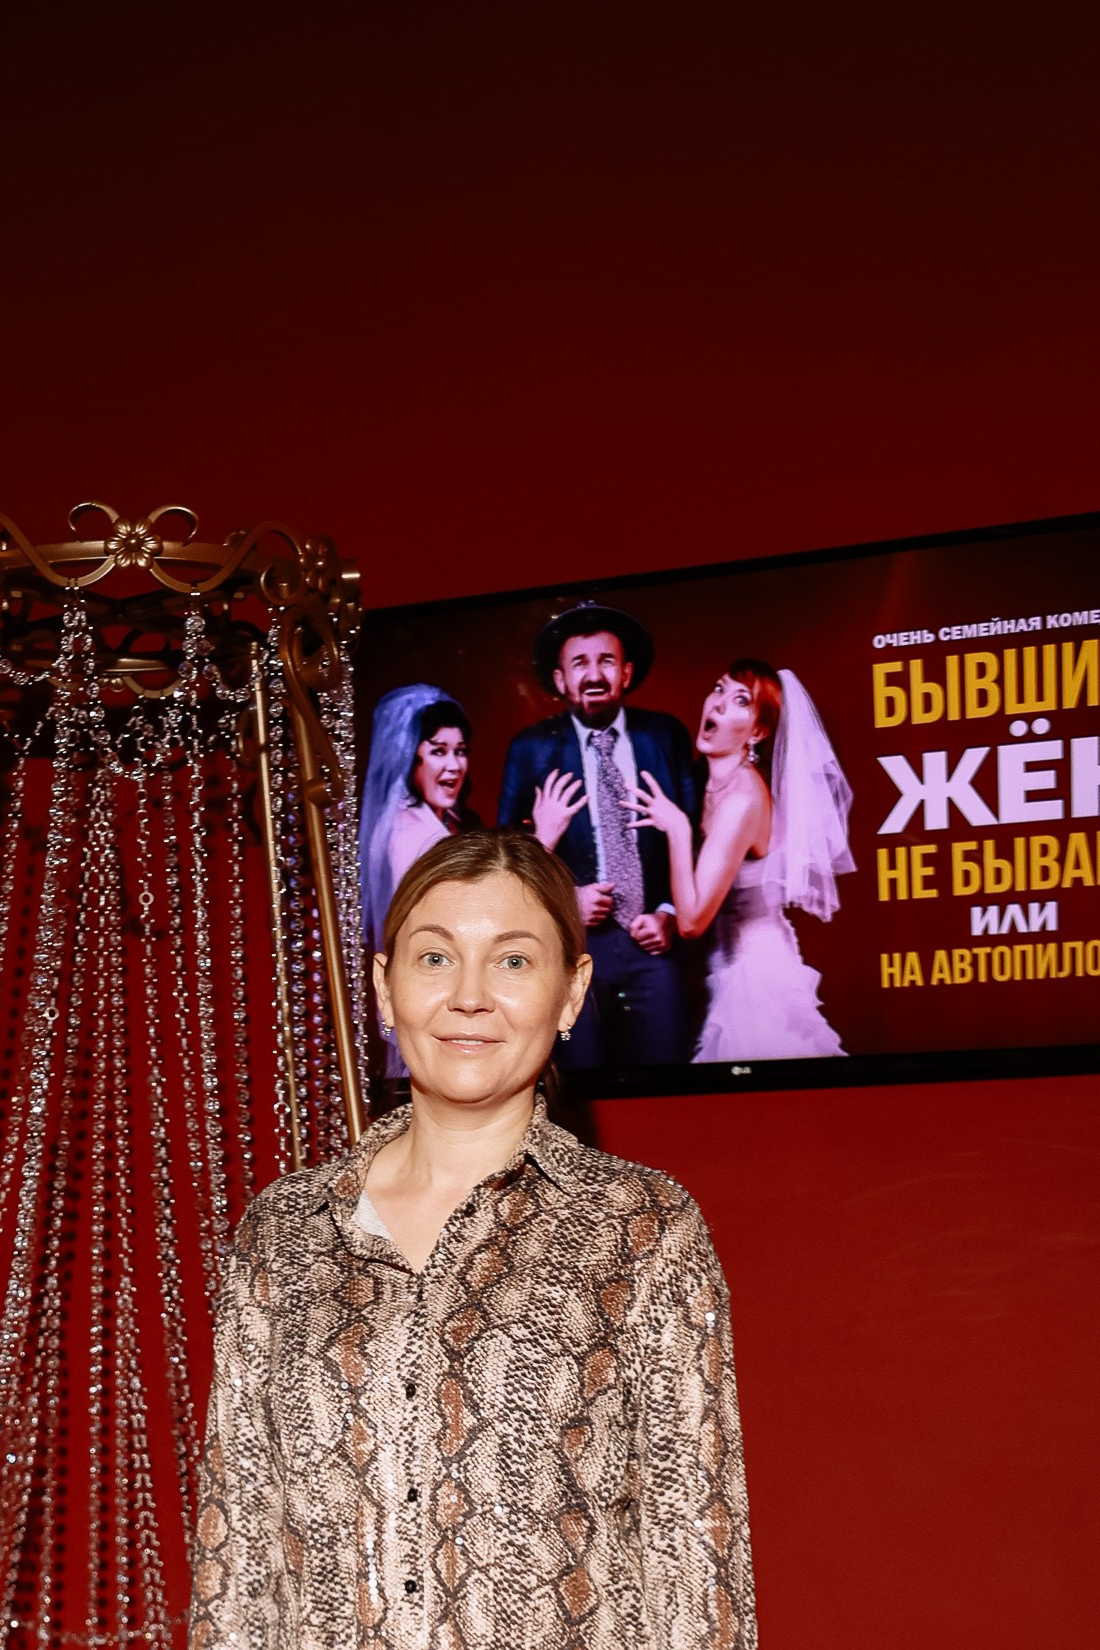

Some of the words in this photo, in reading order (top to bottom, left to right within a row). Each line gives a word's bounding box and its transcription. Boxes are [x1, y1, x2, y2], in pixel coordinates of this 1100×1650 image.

[872, 629, 936, 649] ОЧЕНЬ
[938, 616, 1043, 641] СЕМЕЙНАЯ
[872, 639, 1100, 729] БЫВШИ
[876, 844, 939, 902] НЕ
[951, 830, 1100, 896] БЫВА
[970, 901, 1059, 936] ИЛИ
[880, 951, 925, 988] НА
[930, 939, 1100, 986] АВТОПИЛО
